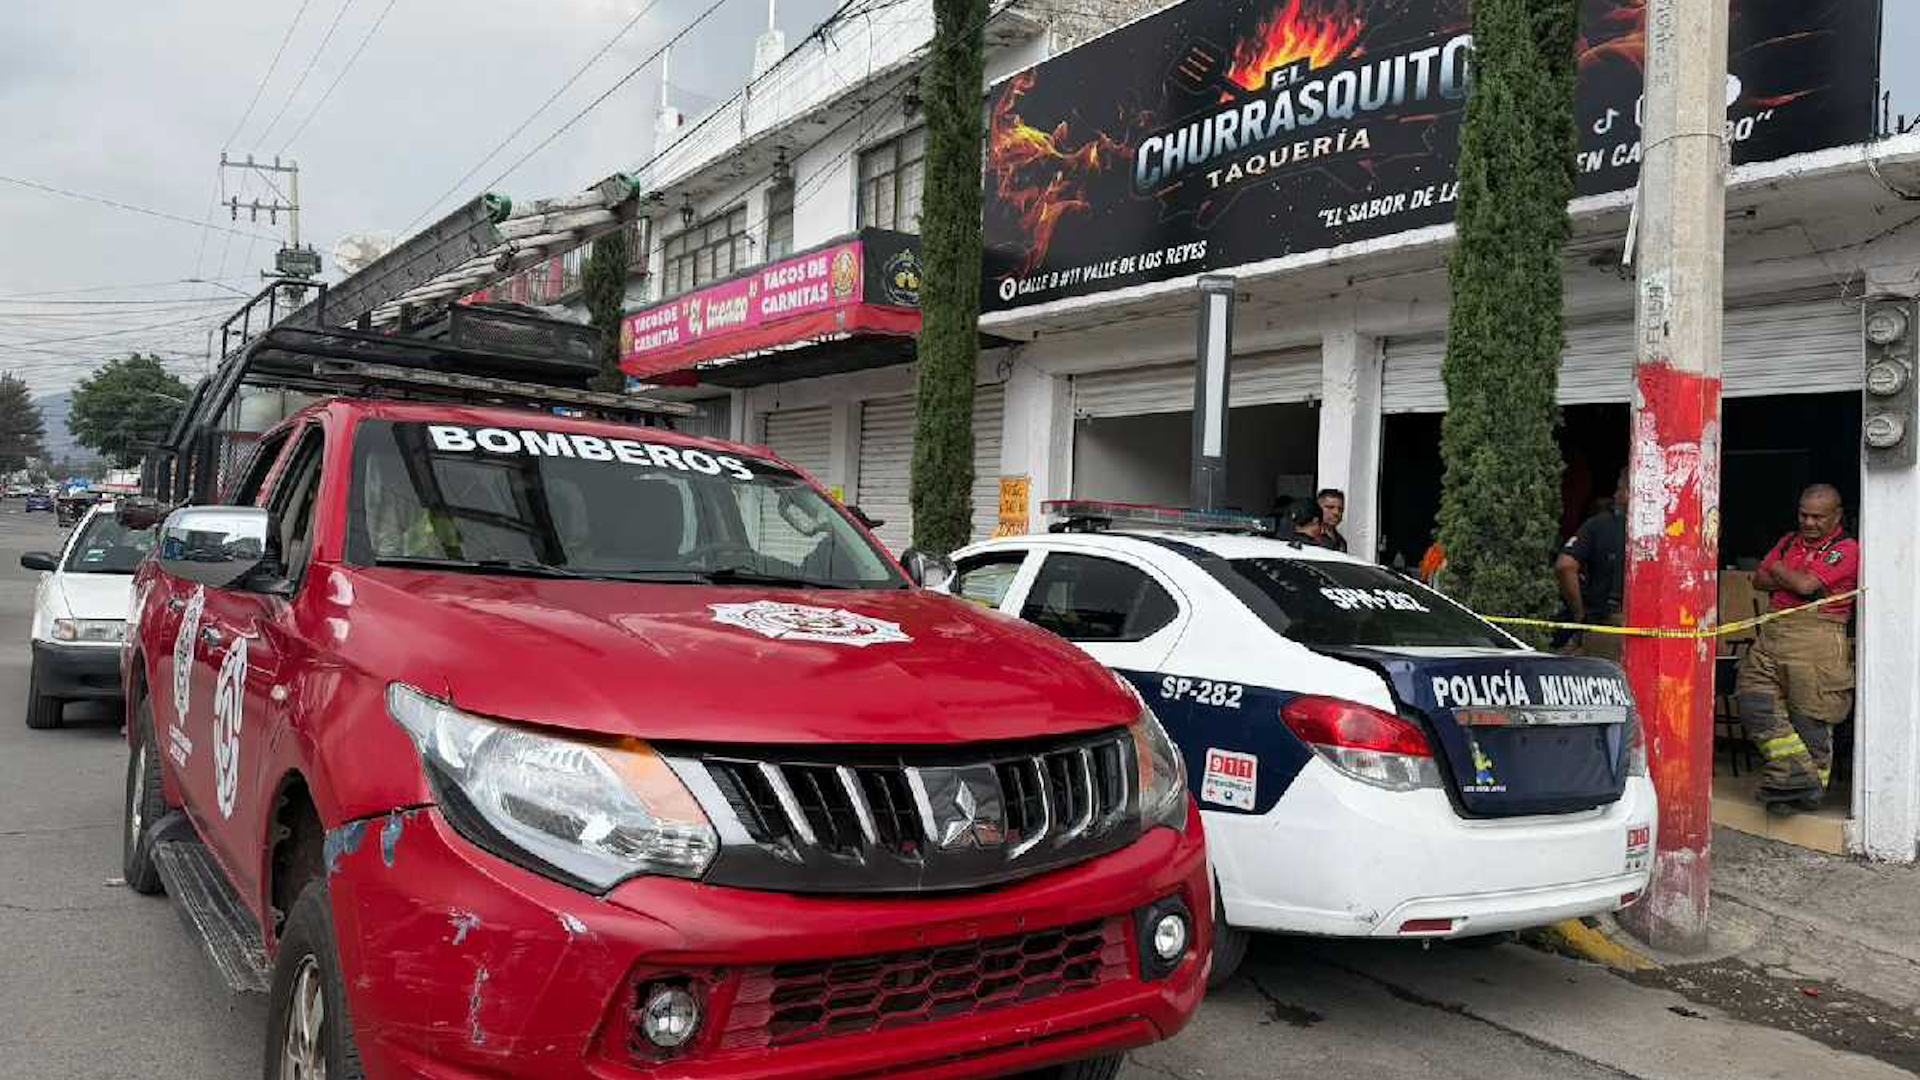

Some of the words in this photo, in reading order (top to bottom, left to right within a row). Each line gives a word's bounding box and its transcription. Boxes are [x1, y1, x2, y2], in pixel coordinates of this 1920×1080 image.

[1271, 65, 1305, 91] EL
[1137, 34, 1474, 191] CHURRASQUITO
[1206, 127, 1370, 189] TAQUERÍA
[1347, 193, 1406, 223] SABOR
[1410, 186, 1435, 210] DE
[1577, 148, 1605, 173] EN
[764, 263, 806, 292] TACOS
[807, 256, 828, 279] DE
[1018, 273, 1049, 295] CALLE
[1083, 262, 1117, 283] VALLE
[1118, 256, 1136, 275] DE
[1138, 250, 1163, 271] LOS
[1165, 240, 1208, 265] REYES
[761, 281, 829, 315] CARNITAS
[634, 309, 665, 334] TACOS
[665, 305, 678, 325] DE
[634, 326, 680, 353] CARNITAS
[427, 424, 756, 481] BOMBEROS
[1160, 675, 1244, 710] SP-282
[1432, 668, 1531, 708] POLICÍA
[1538, 674, 1633, 707] MUNICIPAL
[1212, 757, 1251, 778] 911
